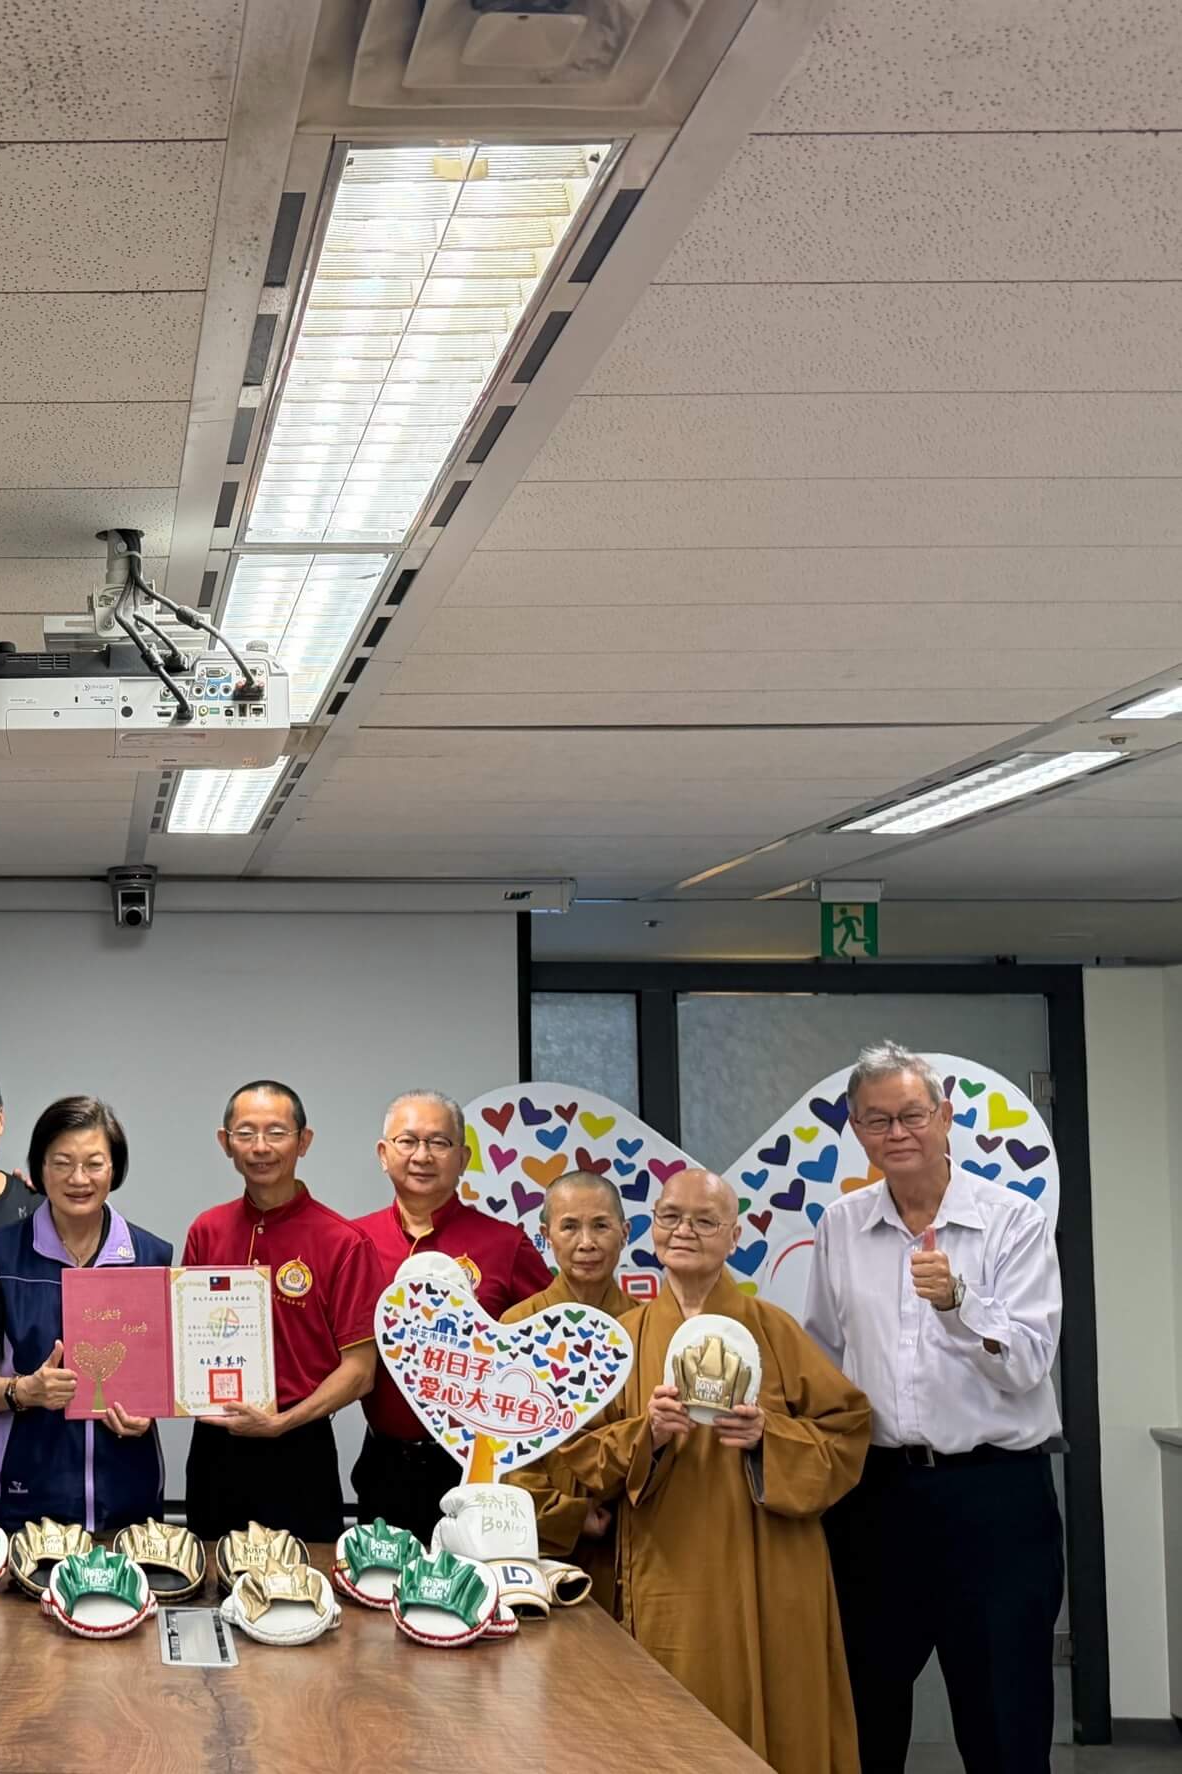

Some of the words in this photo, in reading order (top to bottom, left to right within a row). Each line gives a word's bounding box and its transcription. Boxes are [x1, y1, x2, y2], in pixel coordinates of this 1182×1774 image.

[410, 1327, 458, 1346] 新北市政府
[423, 1346, 492, 1381] 好日子
